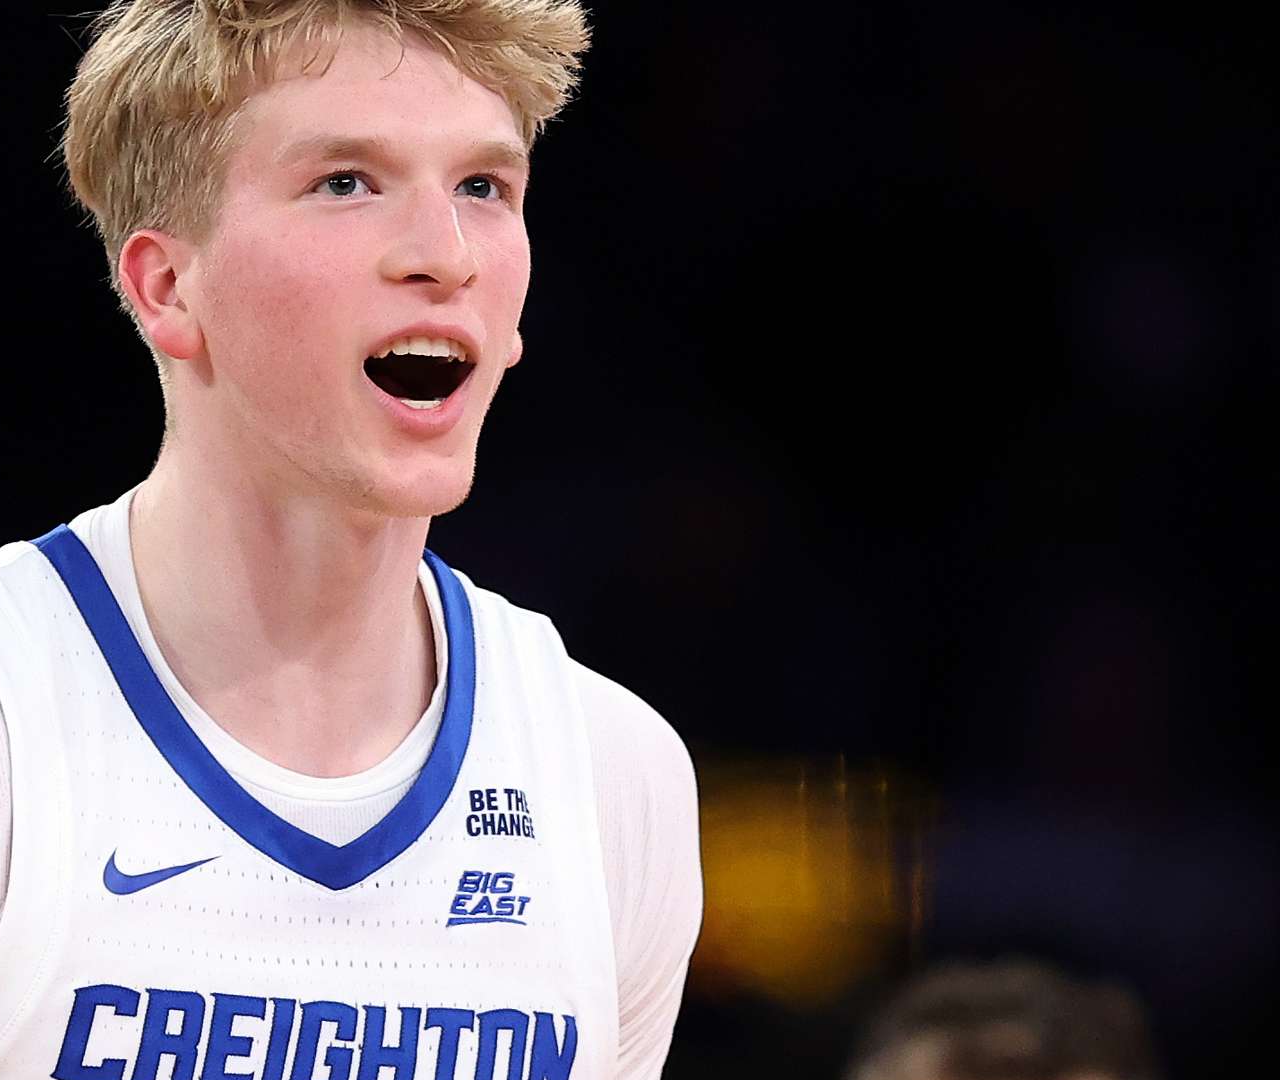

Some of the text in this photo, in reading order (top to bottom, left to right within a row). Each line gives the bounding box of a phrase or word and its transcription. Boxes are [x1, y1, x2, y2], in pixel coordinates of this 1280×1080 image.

[469, 788, 499, 812] BE
[457, 871, 515, 893] BIG
[449, 894, 531, 916] EAST
